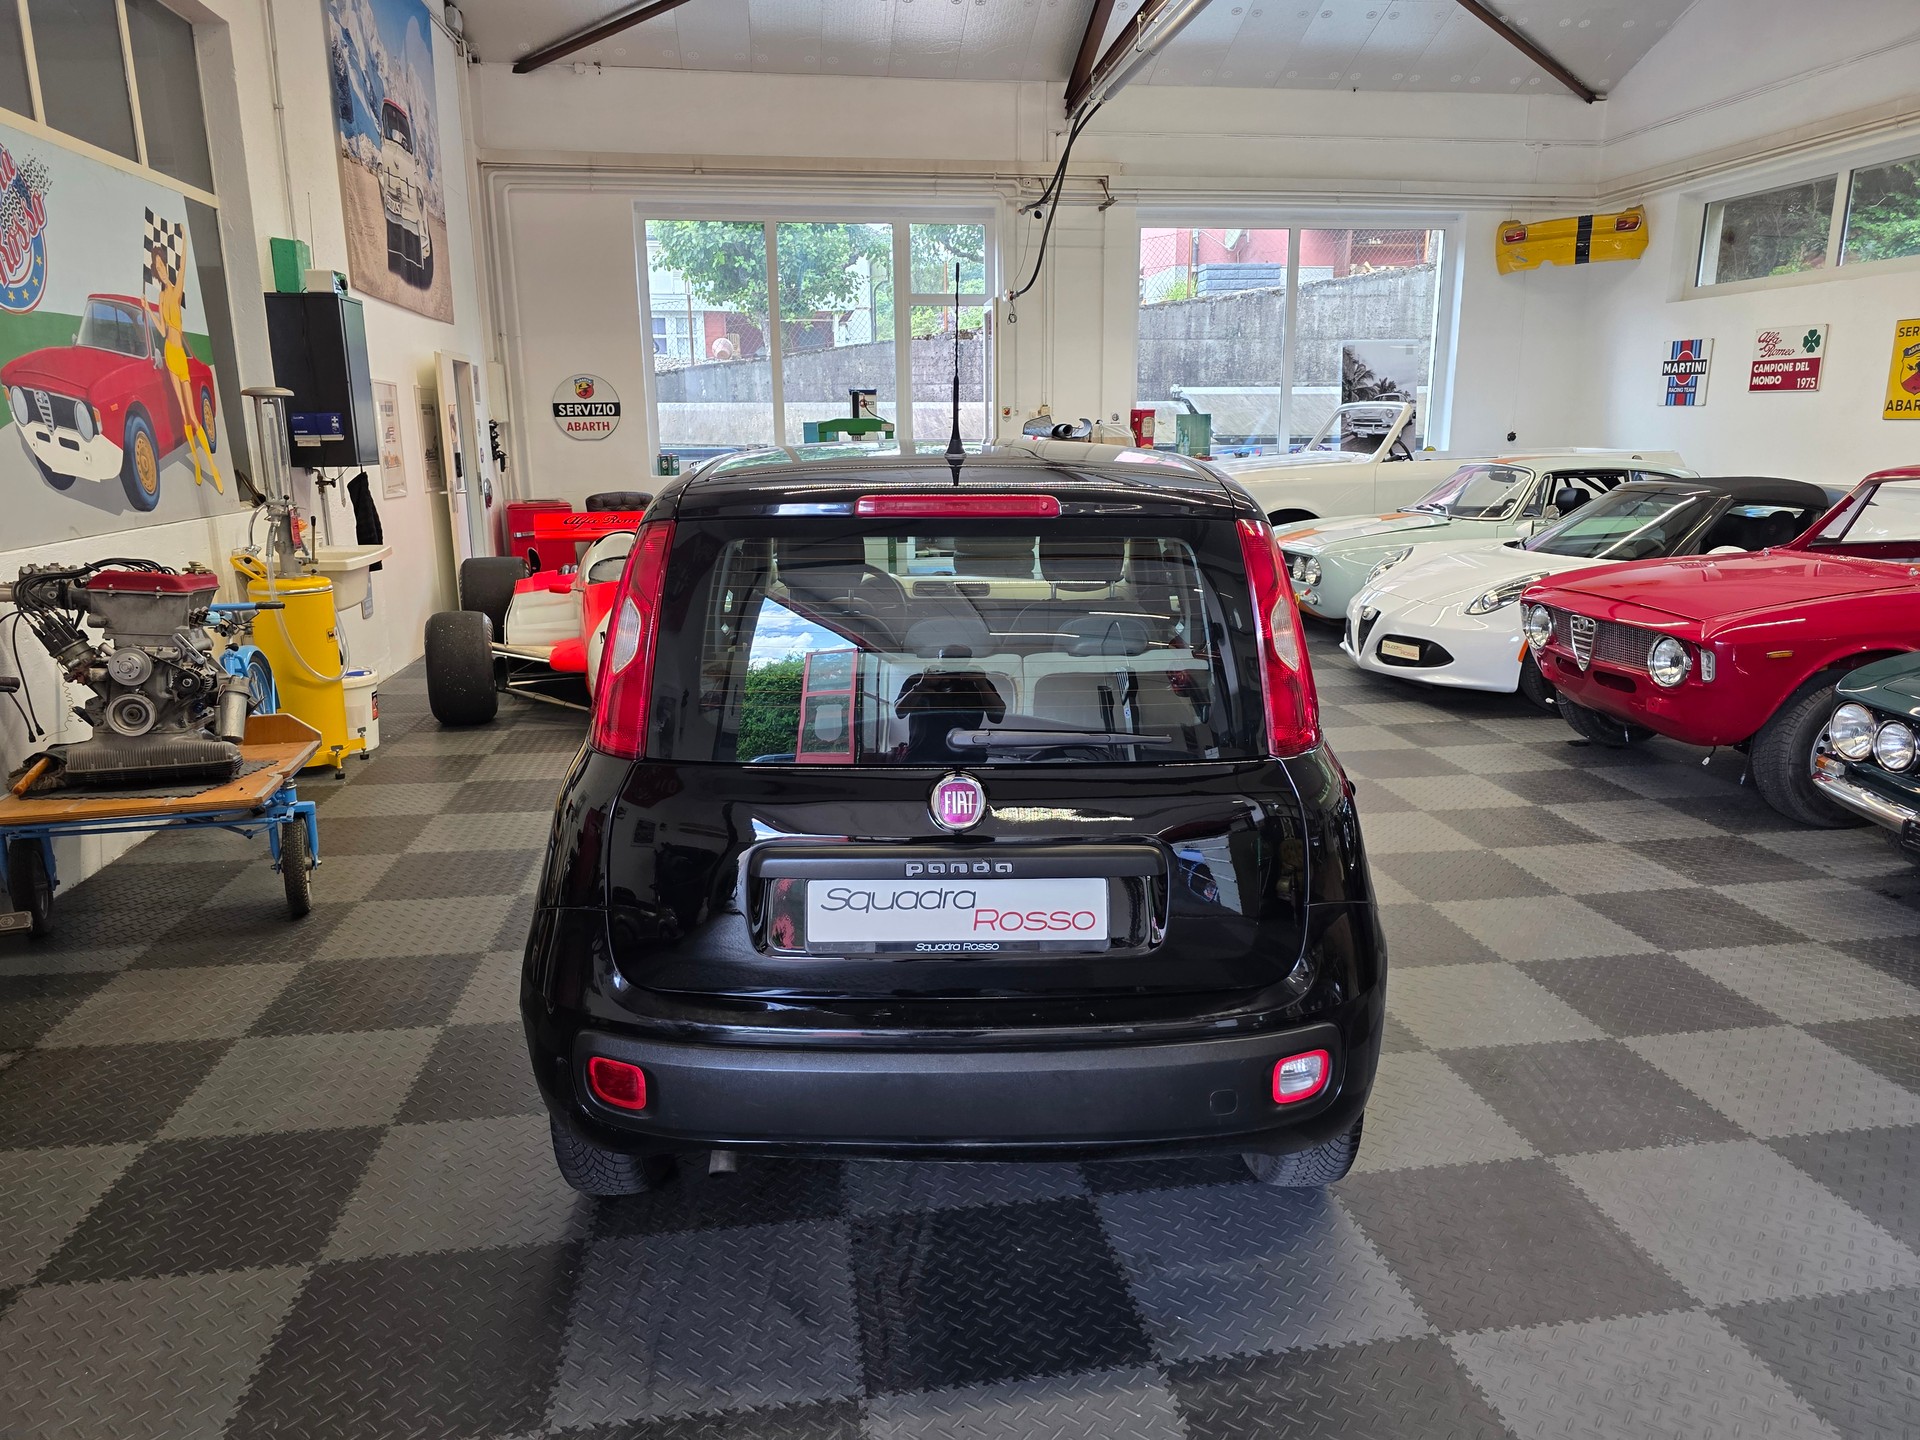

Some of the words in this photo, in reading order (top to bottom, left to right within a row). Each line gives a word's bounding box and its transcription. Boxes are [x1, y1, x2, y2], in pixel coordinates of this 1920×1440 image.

[1758, 331, 1782, 345] Alfa
[1759, 343, 1795, 358] Romeo
[1663, 361, 1706, 374] MARTINI
[1753, 362, 1794, 373] CAMPIONE
[1795, 361, 1810, 371] DEL
[1751, 375, 1782, 386] MONDO
[1796, 377, 1816, 389] 1975
[558, 403, 616, 416] SERVIZIO
[566, 421, 610, 432] ABARTH
[563, 515, 599, 530] Alfa
[944, 790, 975, 815] FIAT
[904, 860, 1014, 878] panda
[820, 887, 977, 914] Squadra
[973, 908, 1096, 932] Rosso
[914, 942, 961, 952] Squadra
[962, 942, 1000, 951] Rosso
